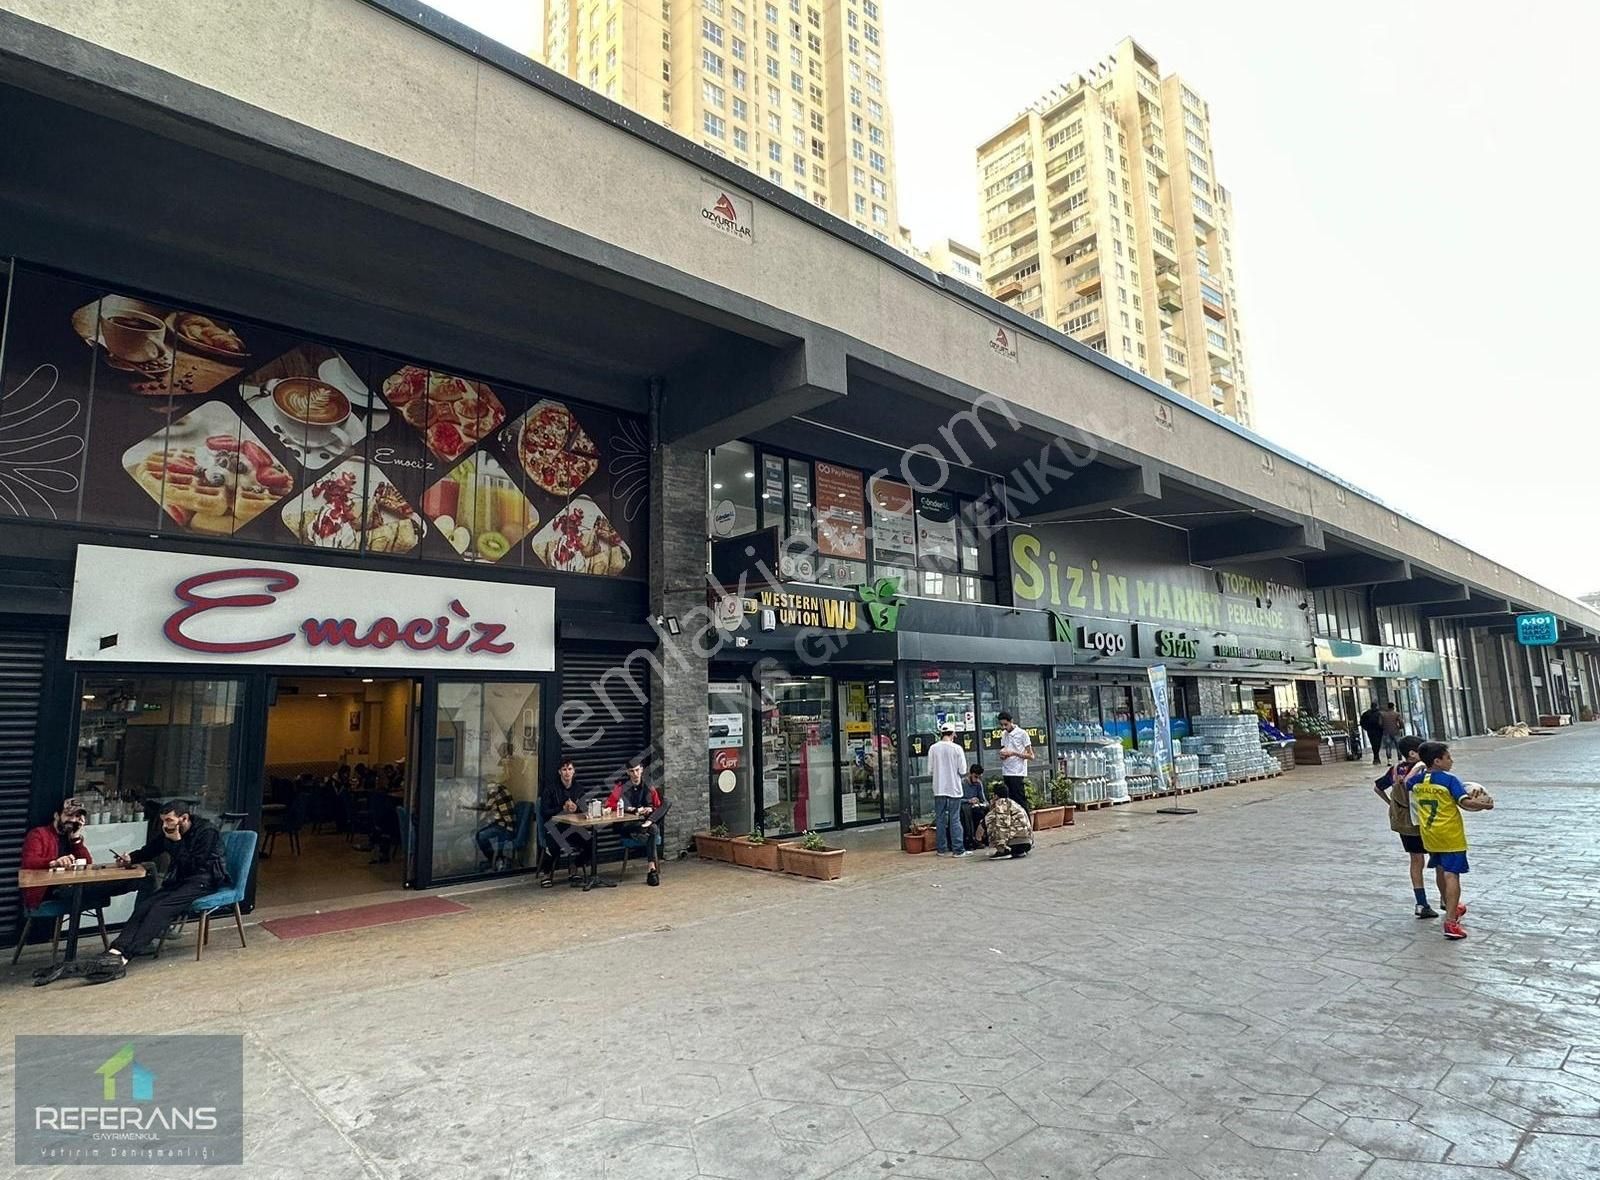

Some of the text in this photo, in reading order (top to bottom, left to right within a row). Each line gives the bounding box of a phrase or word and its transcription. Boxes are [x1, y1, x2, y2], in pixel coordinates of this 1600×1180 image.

[1223, 572, 1264, 598] TOPTAN
[760, 591, 819, 611] WESTERN
[824, 599, 857, 630] WU
[1136, 579, 1221, 626] MARKET
[780, 609, 819, 626] UNION
[1227, 603, 1284, 629] PERAKENDE
[1083, 626, 1126, 656] Logo
[1420, 799, 1438, 829] 7
